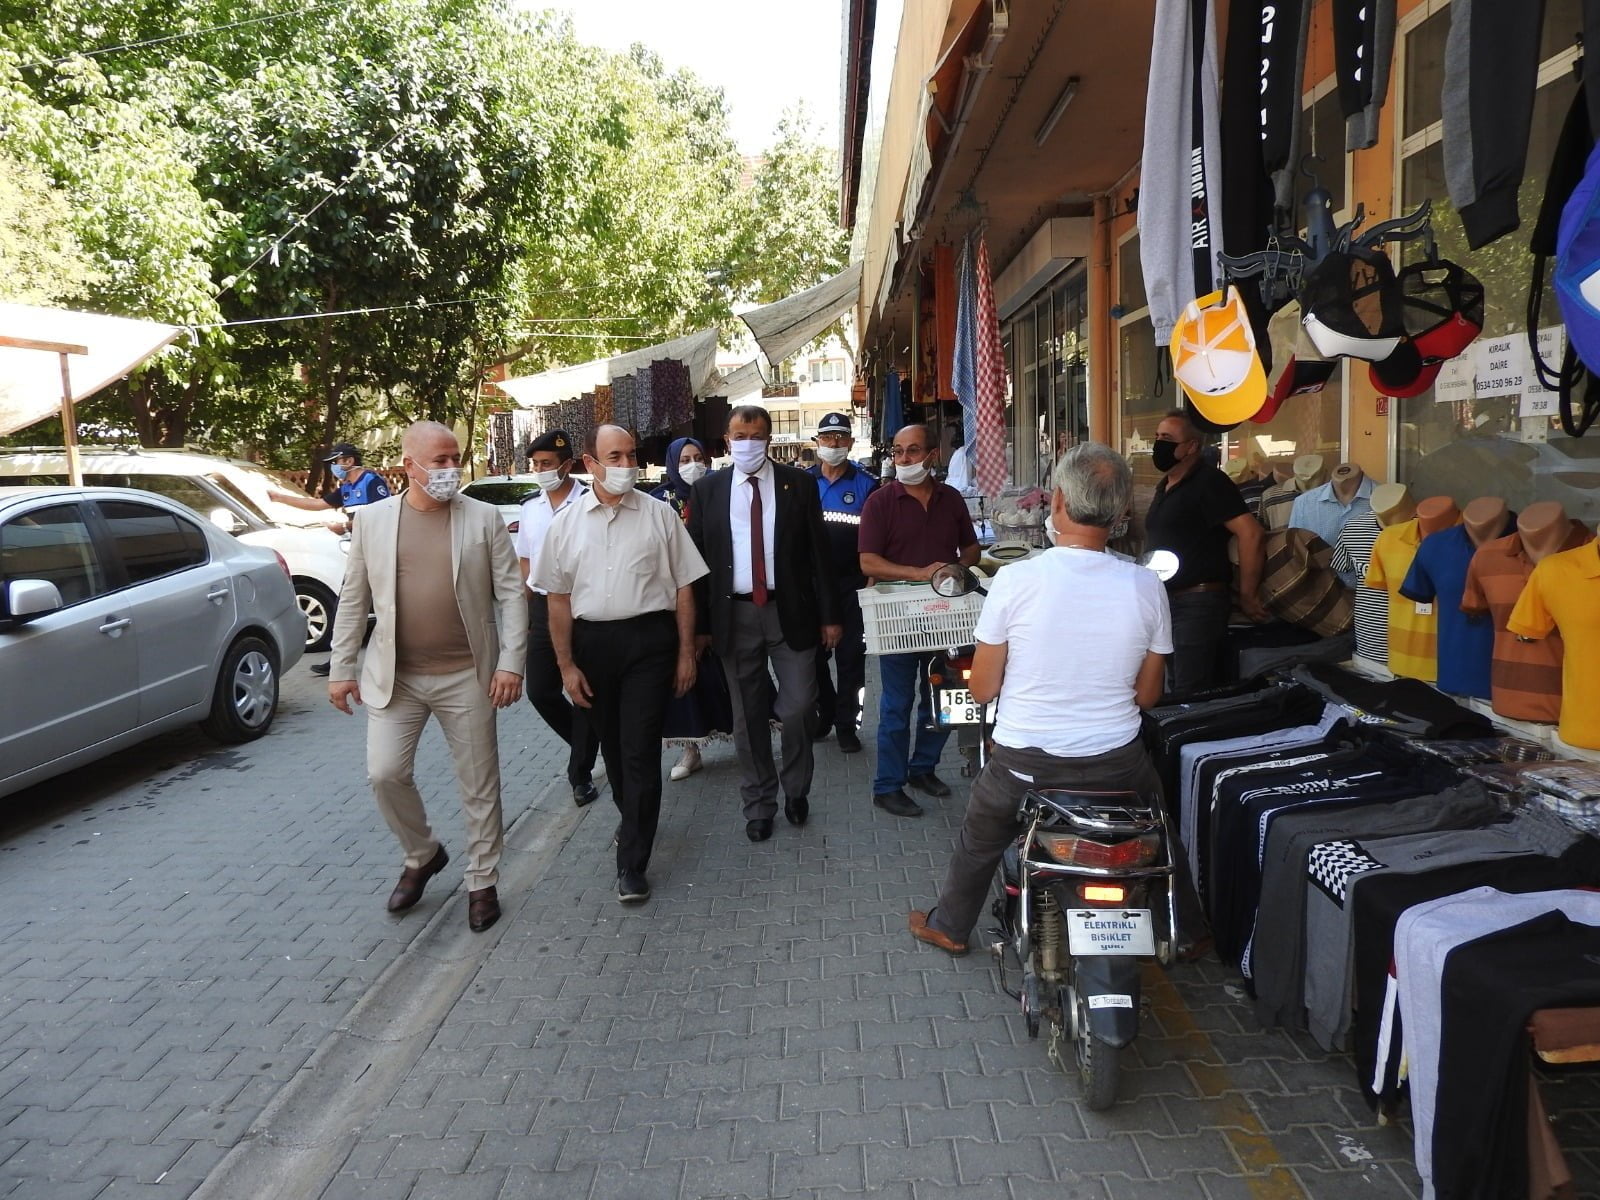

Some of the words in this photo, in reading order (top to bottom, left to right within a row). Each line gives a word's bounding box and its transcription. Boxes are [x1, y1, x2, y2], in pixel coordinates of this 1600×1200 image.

[1192, 218, 1209, 249] AIR
[1488, 342, 1511, 354] KİRALIK
[1490, 360, 1508, 370] DAİRE
[1477, 380, 1491, 391] 0534
[1492, 378, 1504, 389] 250
[1504, 377, 1513, 387] 96
